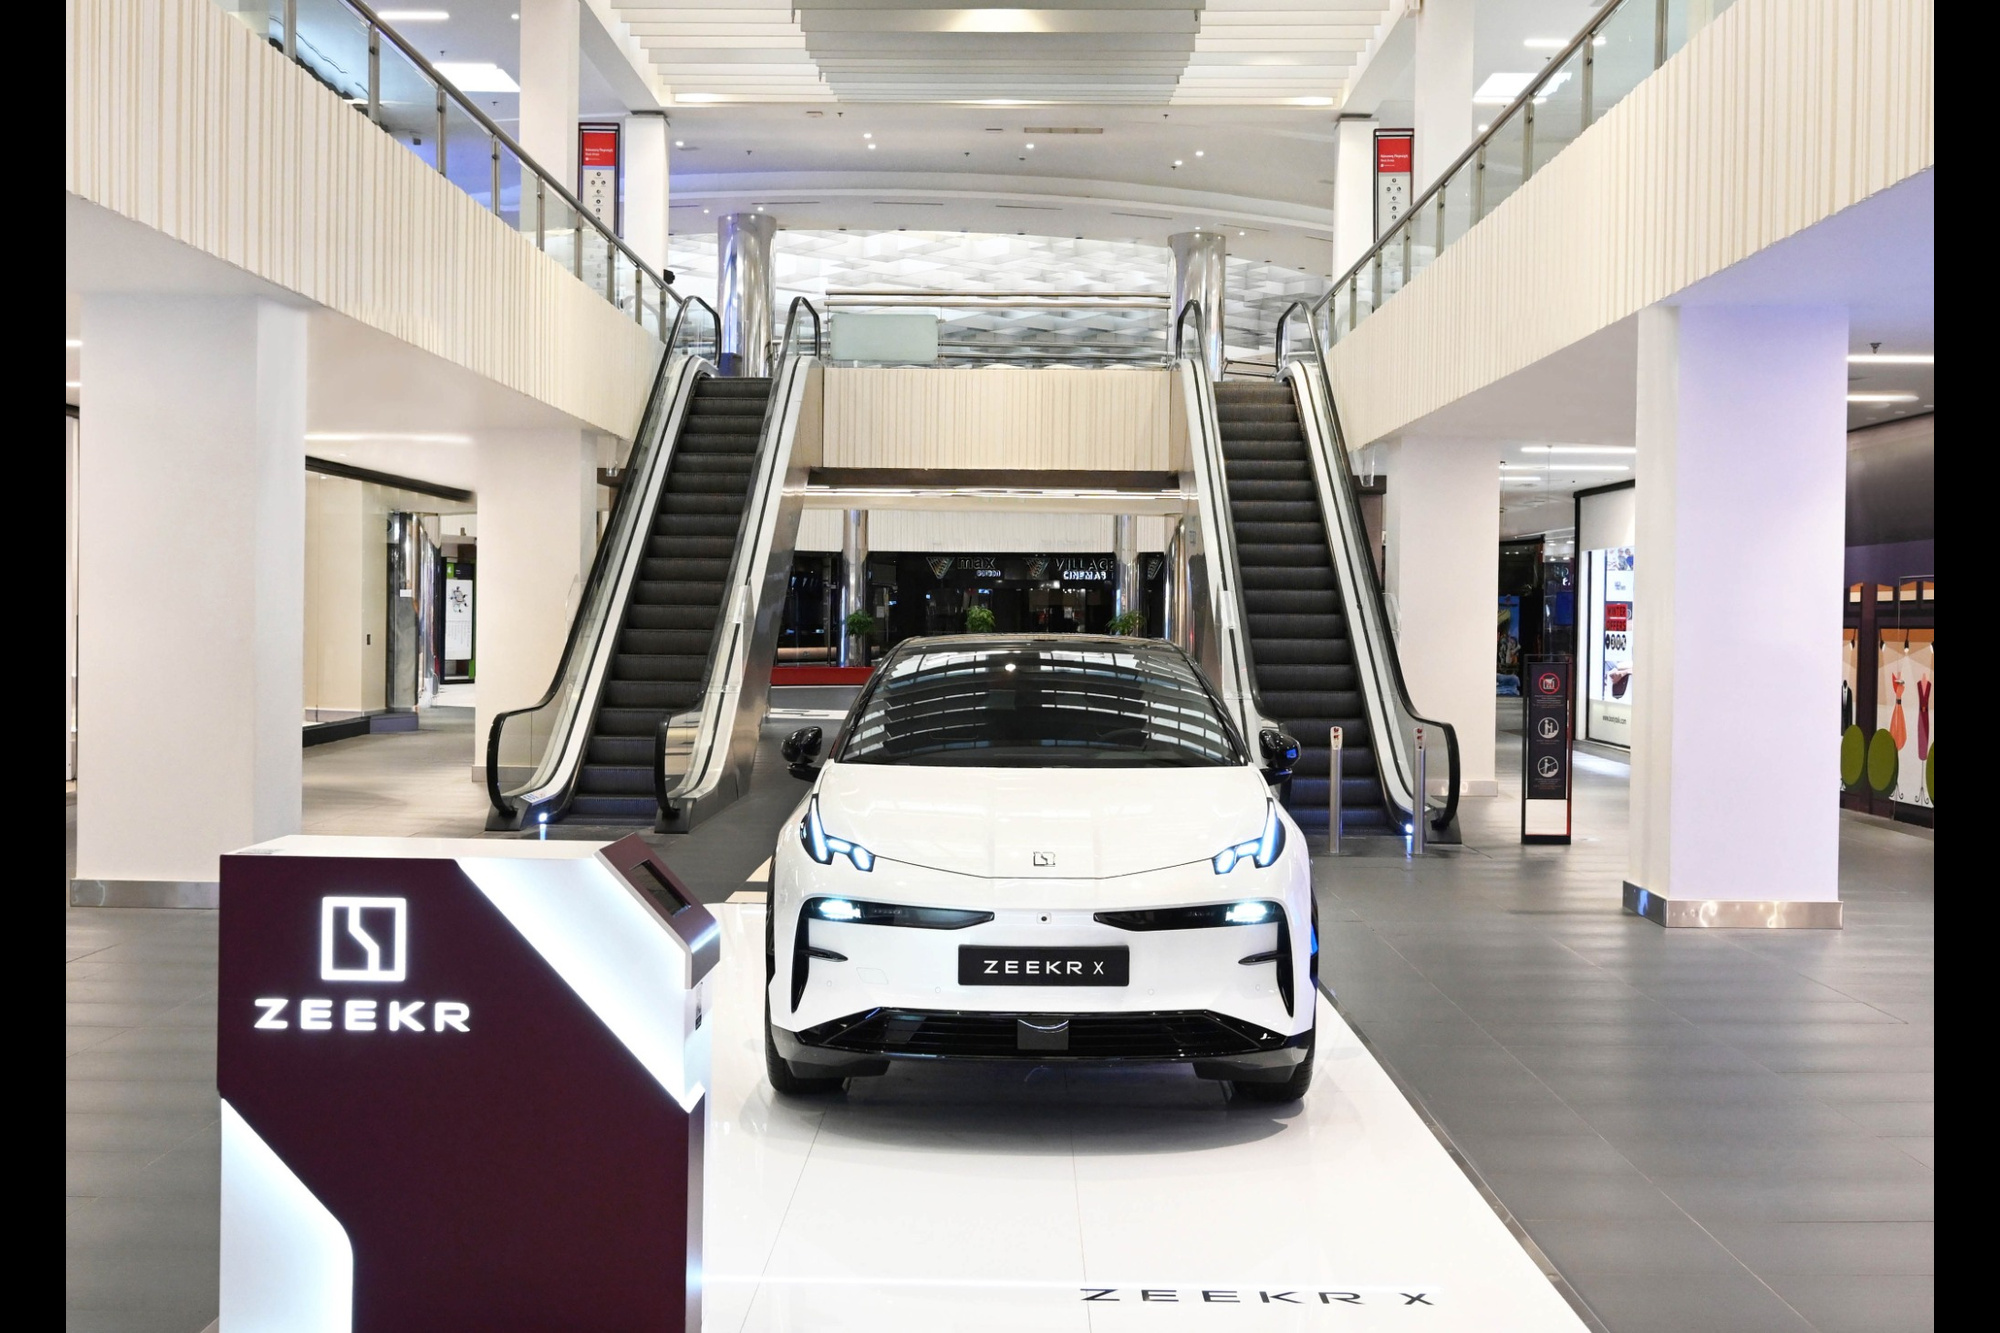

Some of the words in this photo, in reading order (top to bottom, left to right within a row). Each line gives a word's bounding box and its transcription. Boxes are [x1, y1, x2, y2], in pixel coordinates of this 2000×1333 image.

[957, 556, 996, 570] max
[1063, 570, 1107, 580] CINEMAS
[1607, 605, 1626, 617] WINTER
[1605, 619, 1627, 631] OFFERS
[983, 960, 1083, 975] ZEEKR
[1093, 961, 1104, 975] X
[254, 998, 471, 1033] ZEEKR
[1080, 1288, 1366, 1305] ZEEKR
[1399, 1292, 1435, 1306] X
